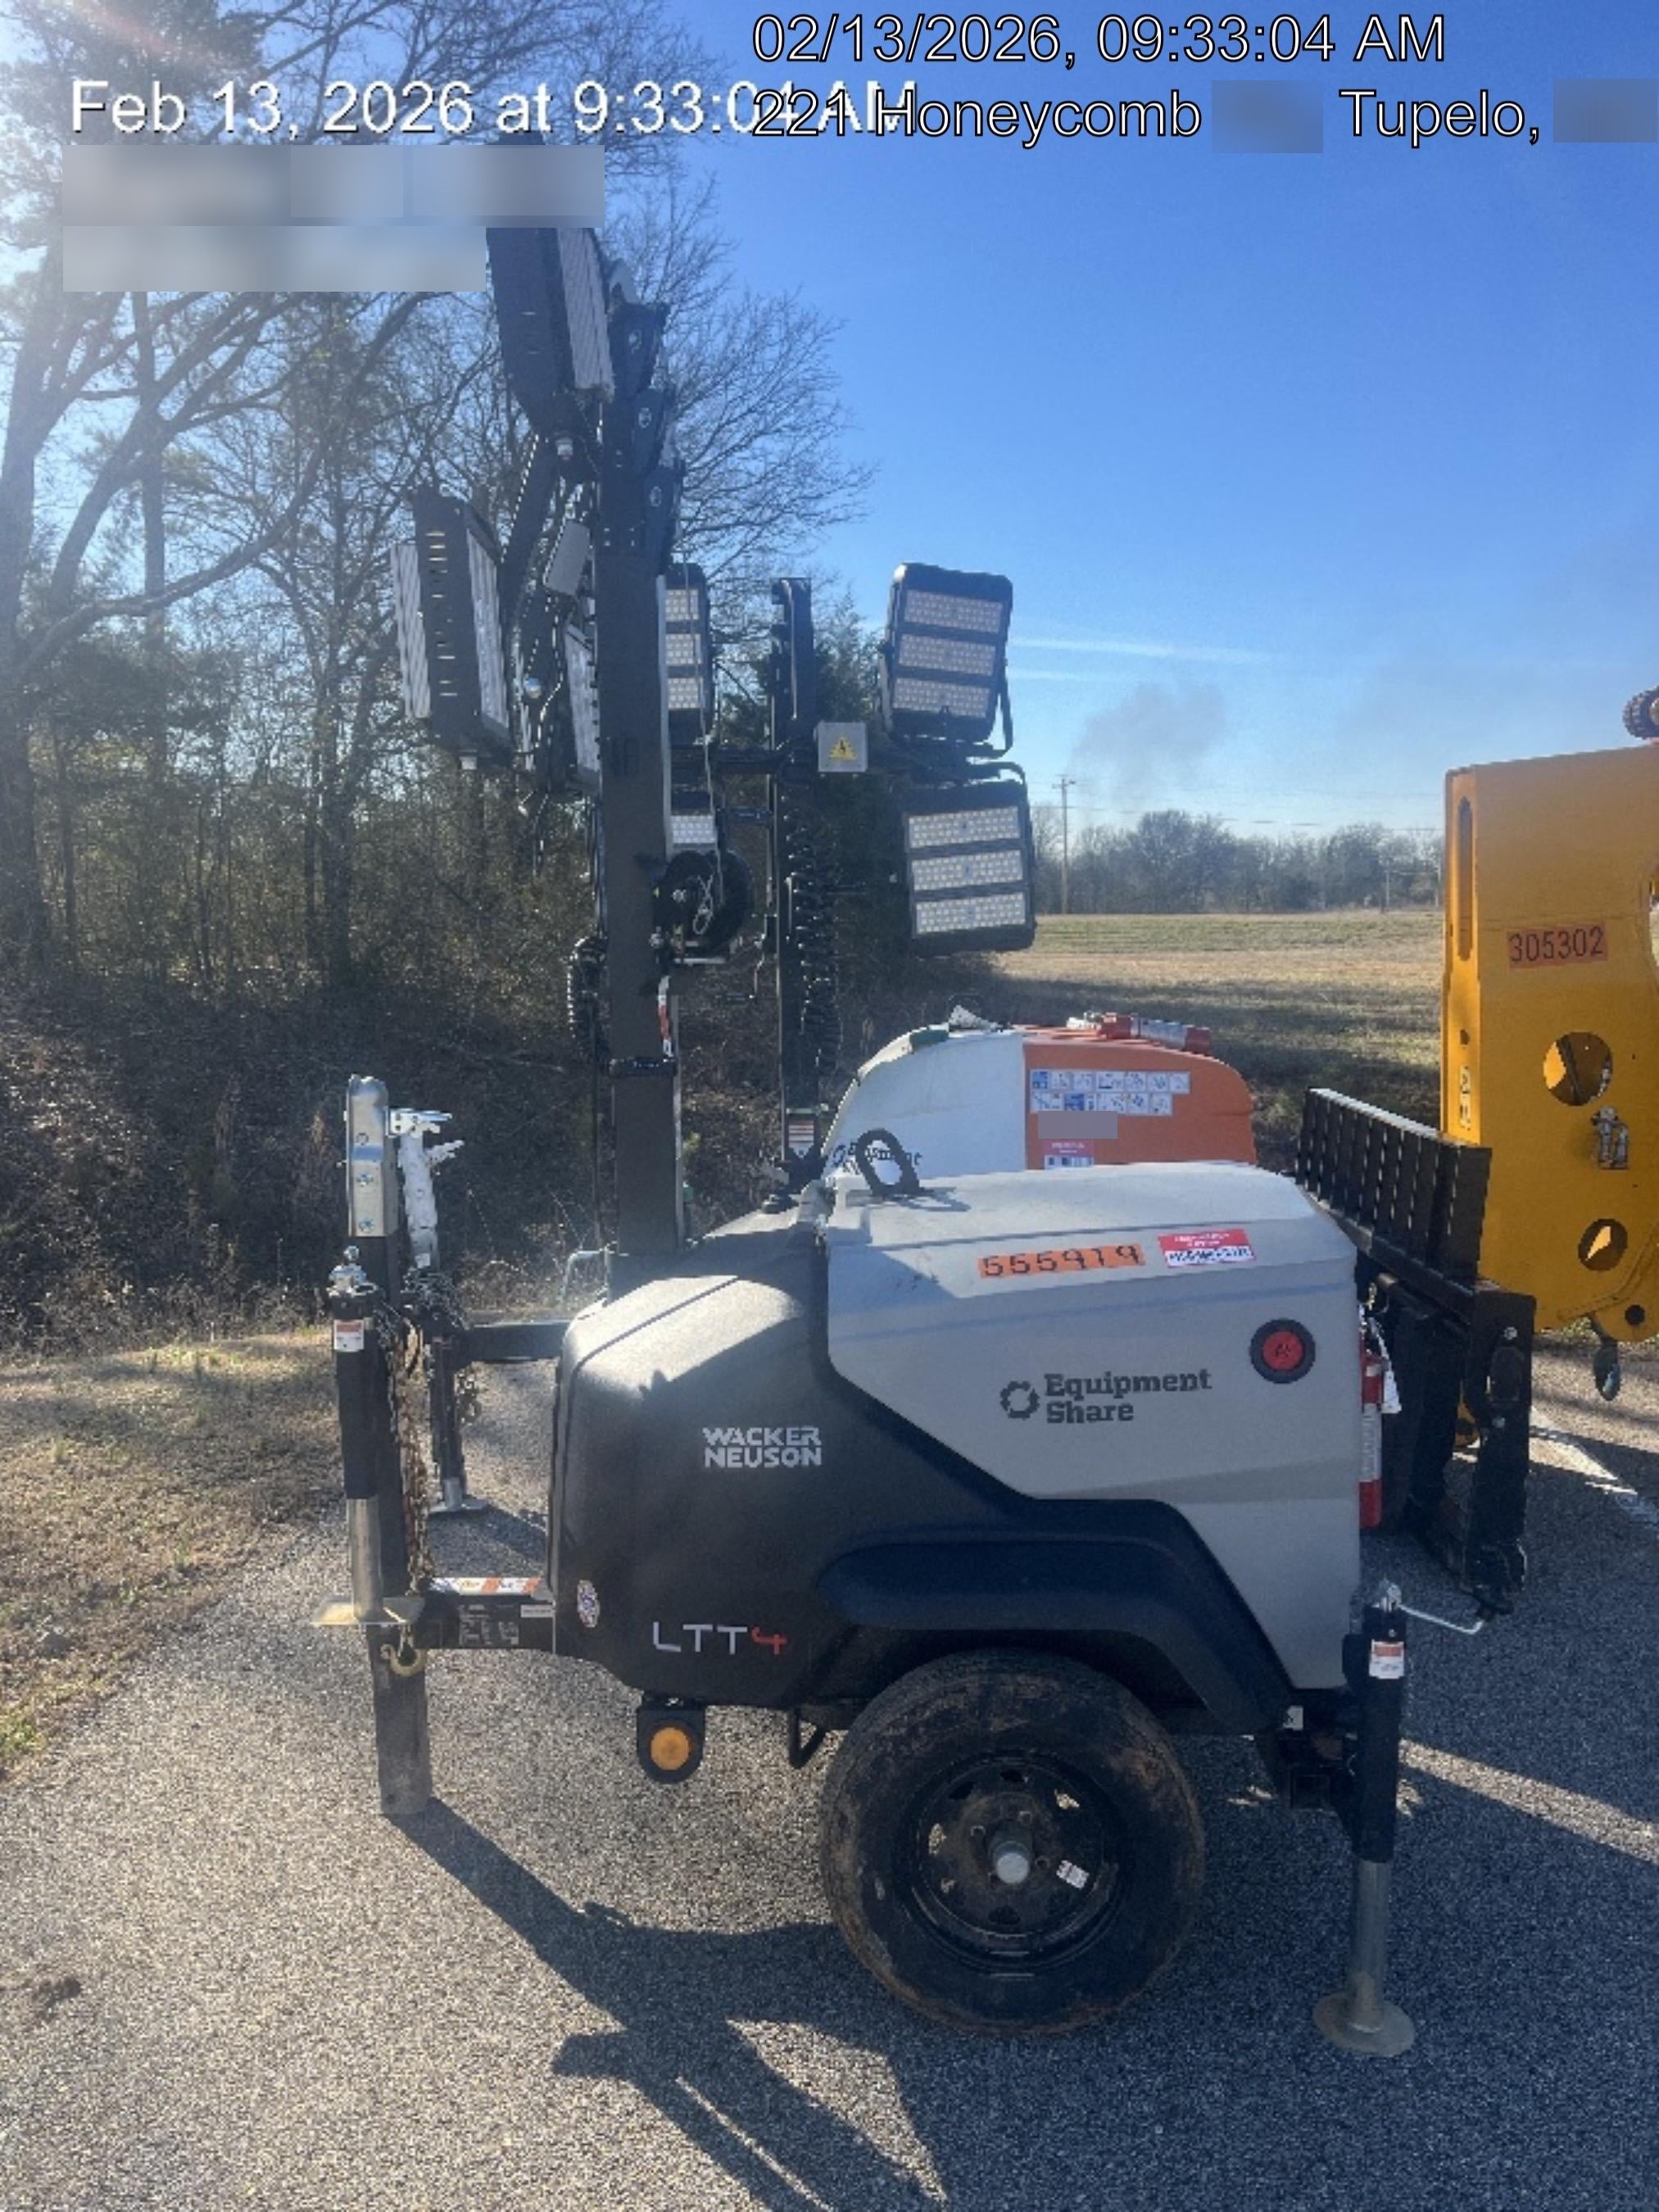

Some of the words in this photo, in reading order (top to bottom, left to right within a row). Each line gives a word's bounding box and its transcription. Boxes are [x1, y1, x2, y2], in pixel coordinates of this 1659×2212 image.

[1508, 926, 1604, 963] 305302
[1044, 1368, 1213, 1401] Equipment
[1046, 1400, 1135, 1424] Share
[702, 1427, 823, 1446] WACKER
[705, 1447, 823, 1468] NEUSON
